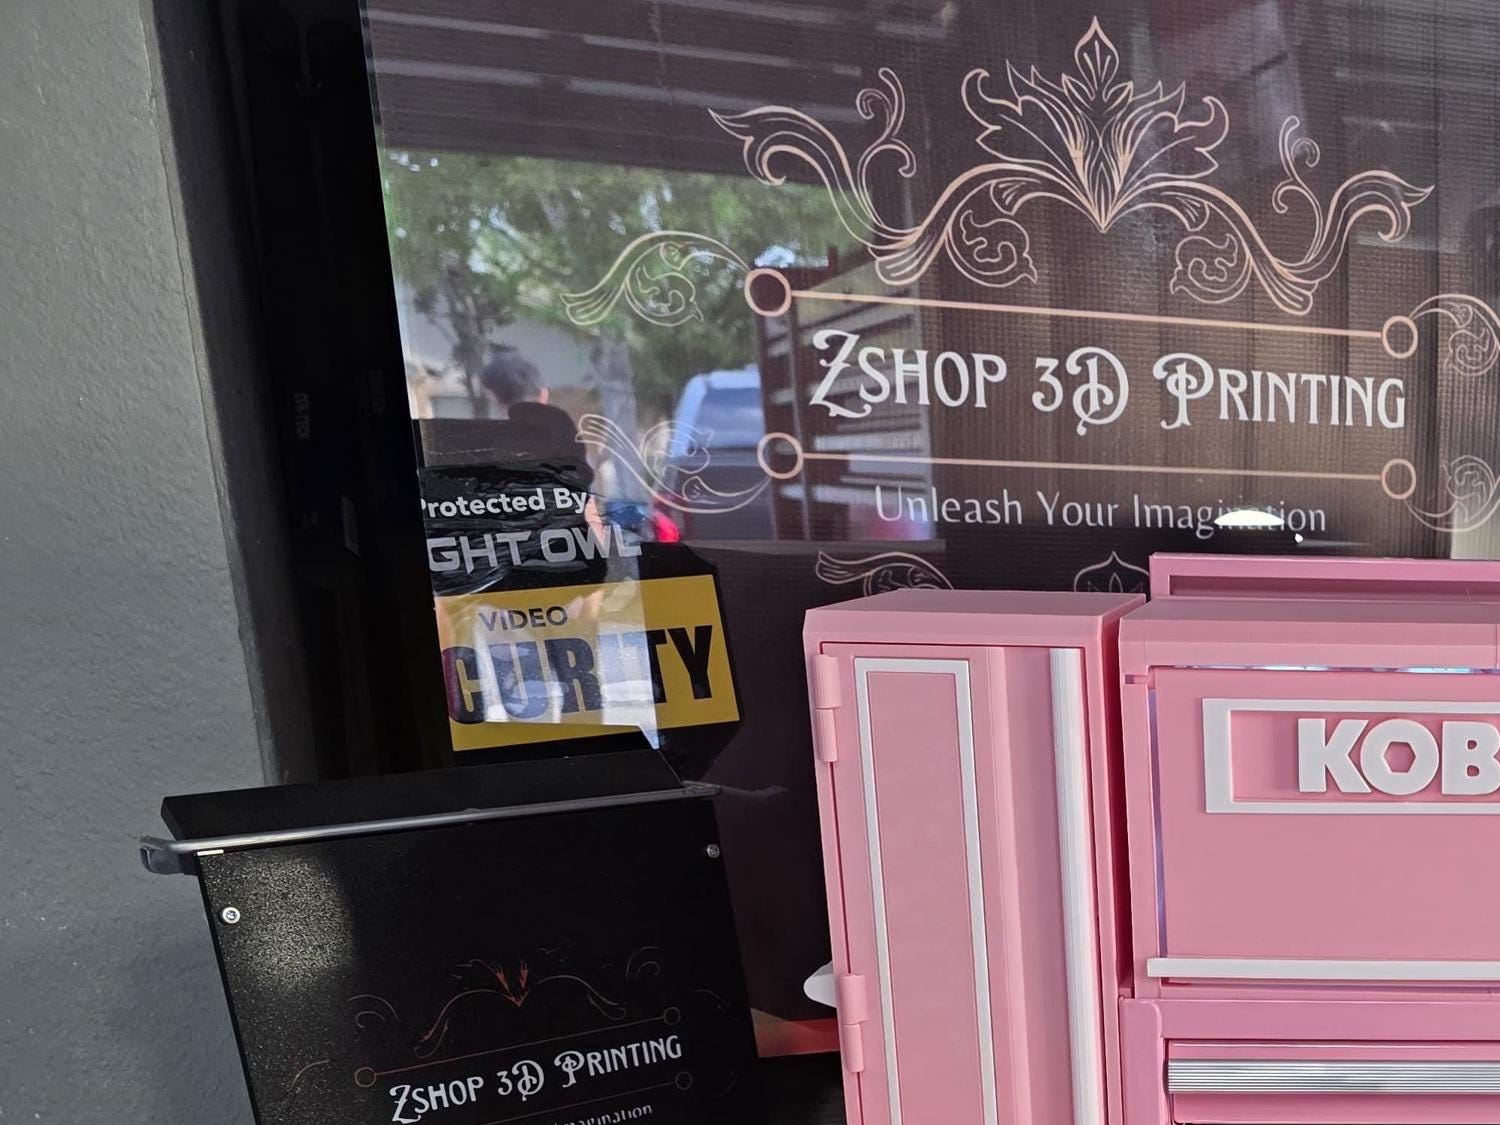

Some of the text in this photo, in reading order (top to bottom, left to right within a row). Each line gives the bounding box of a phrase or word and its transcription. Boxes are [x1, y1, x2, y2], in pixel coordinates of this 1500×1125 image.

[1031, 346, 1130, 437] 3D
[552, 486, 588, 515] By
[875, 484, 1024, 527] Unleash
[1036, 489, 1120, 529] Your
[540, 523, 642, 565] OWL
[478, 605, 568, 632] VIDEO
[496, 1059, 545, 1102] 3D
